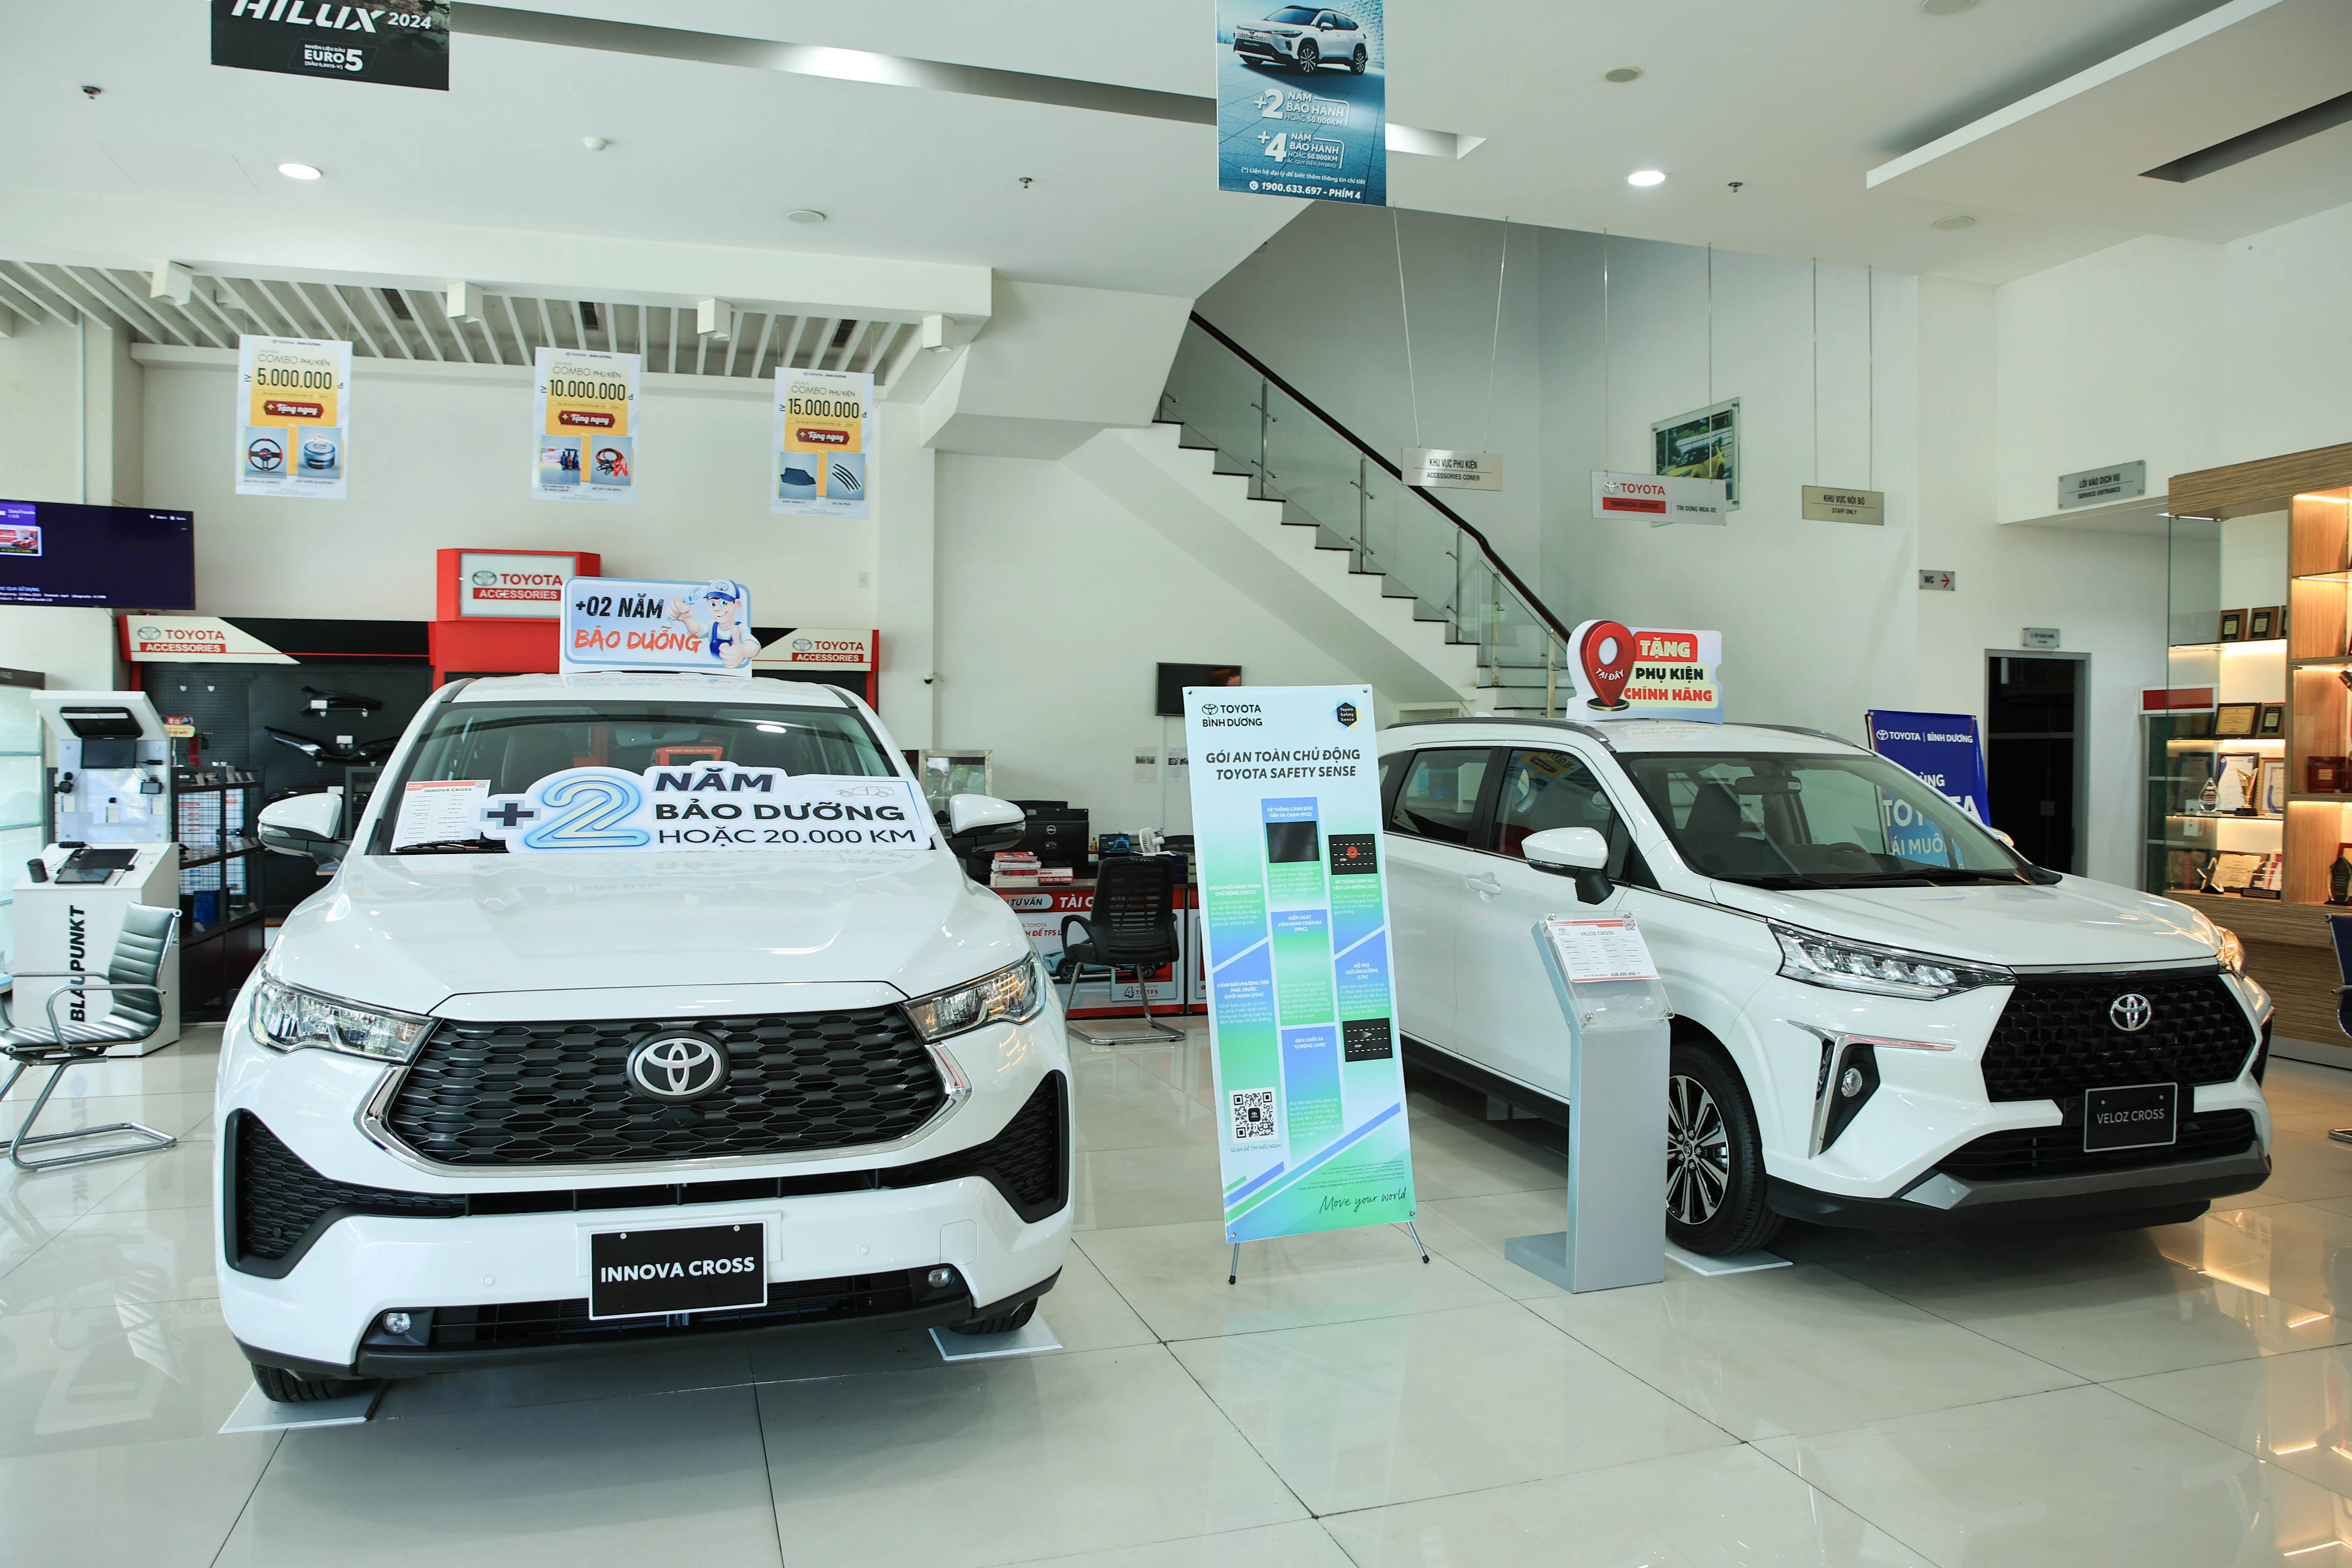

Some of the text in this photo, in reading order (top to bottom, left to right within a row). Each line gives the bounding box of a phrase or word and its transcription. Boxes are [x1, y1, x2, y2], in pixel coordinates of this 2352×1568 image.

[231, 0, 432, 33] HILUX 2024
[304, 49, 363, 72] EURO 5
[1254, 88, 1285, 119] +2
[1288, 91, 1313, 102] NĂM
[1286, 99, 1345, 118] BẢO HÀNH
[1284, 113, 1343, 126] HOẶC 50.000KM
[1291, 132, 1312, 142] NĂM
[1257, 131, 1287, 163] +4
[1289, 139, 1339, 155] BẢO HÀNH
[1288, 151, 1338, 162] HOẶC 50.000KM
[1262, 168, 1270, 177] hệ
[1270, 168, 1280, 177] đại
[1280, 169, 1286, 178] lý
[1286, 169, 1294, 178] để
[1294, 170, 1306, 179] biết
[1306, 172, 1321, 181] thêm
[1322, 173, 1338, 184] thông
[1356, 176, 1366, 185] tiết
[1262, 182, 1361, 199] 1900.633.697 PHÍM 4
[258, 353, 298, 364] COMBO
[553, 366, 591, 376] COMBO
[257, 368, 332, 389] 5.000.000
[549, 379, 625, 401] 10.000.000
[791, 385, 827, 395] COMBO
[276, 403, 318, 416] Tặng ngay
[788, 398, 859, 419] 15.000.000
[570, 413, 610, 426] Tặng ngay
[808, 431, 845, 442] Tặng ngay
[1429, 458, 1478, 471] KHU VỰC PHỤ KIỆN
[1620, 483, 1666, 495] TOYOTA
[500, 573, 564, 586] TOYOTA
[479, 589, 558, 600] ACCESSORIES
[576, 593, 665, 619] +02 NĂM
[165, 629, 226, 640] TOYOTA
[575, 625, 621, 651] BẢO
[145, 643, 221, 653] ACCESSORIES
[815, 640, 864, 652] TOYOTA
[1639, 637, 1691, 659] TẶNG
[796, 654, 860, 662] ACCESSORIES
[1595, 668, 1624, 681] TẠI ĐÂY
[1635, 666, 1704, 683] PHỤ KIỆN
[1623, 686, 1712, 701] CHÍNH HÃNG
[1220, 704, 1262, 714] TOYOTA
[1202, 717, 1262, 727] BÌNH DƯƠNG
[1889, 731, 1973, 743] TOYOTA BÌNH DƯƠNG
[1206, 747, 1360, 763] GÓI AN TOÀN CHỦ ĐỘNG
[1216, 765, 1356, 780] TOYOTA SAFETY SENSE
[655, 768, 773, 792] NĂM
[655, 798, 905, 821] BẢO DƯỠNG
[659, 826, 916, 847] HOẶC 20.000 KM
[1012, 894, 1083, 908] TƯ VẤN TÀI
[1032, 928, 1044, 936] ĐỂ
[1124, 986, 1134, 998] 4
[2097, 1108, 2165, 1124] VELOZ CROSS
[1319, 1186, 1407, 1213] Move your world
[601, 1256, 755, 1283] INNOVA CROSS
